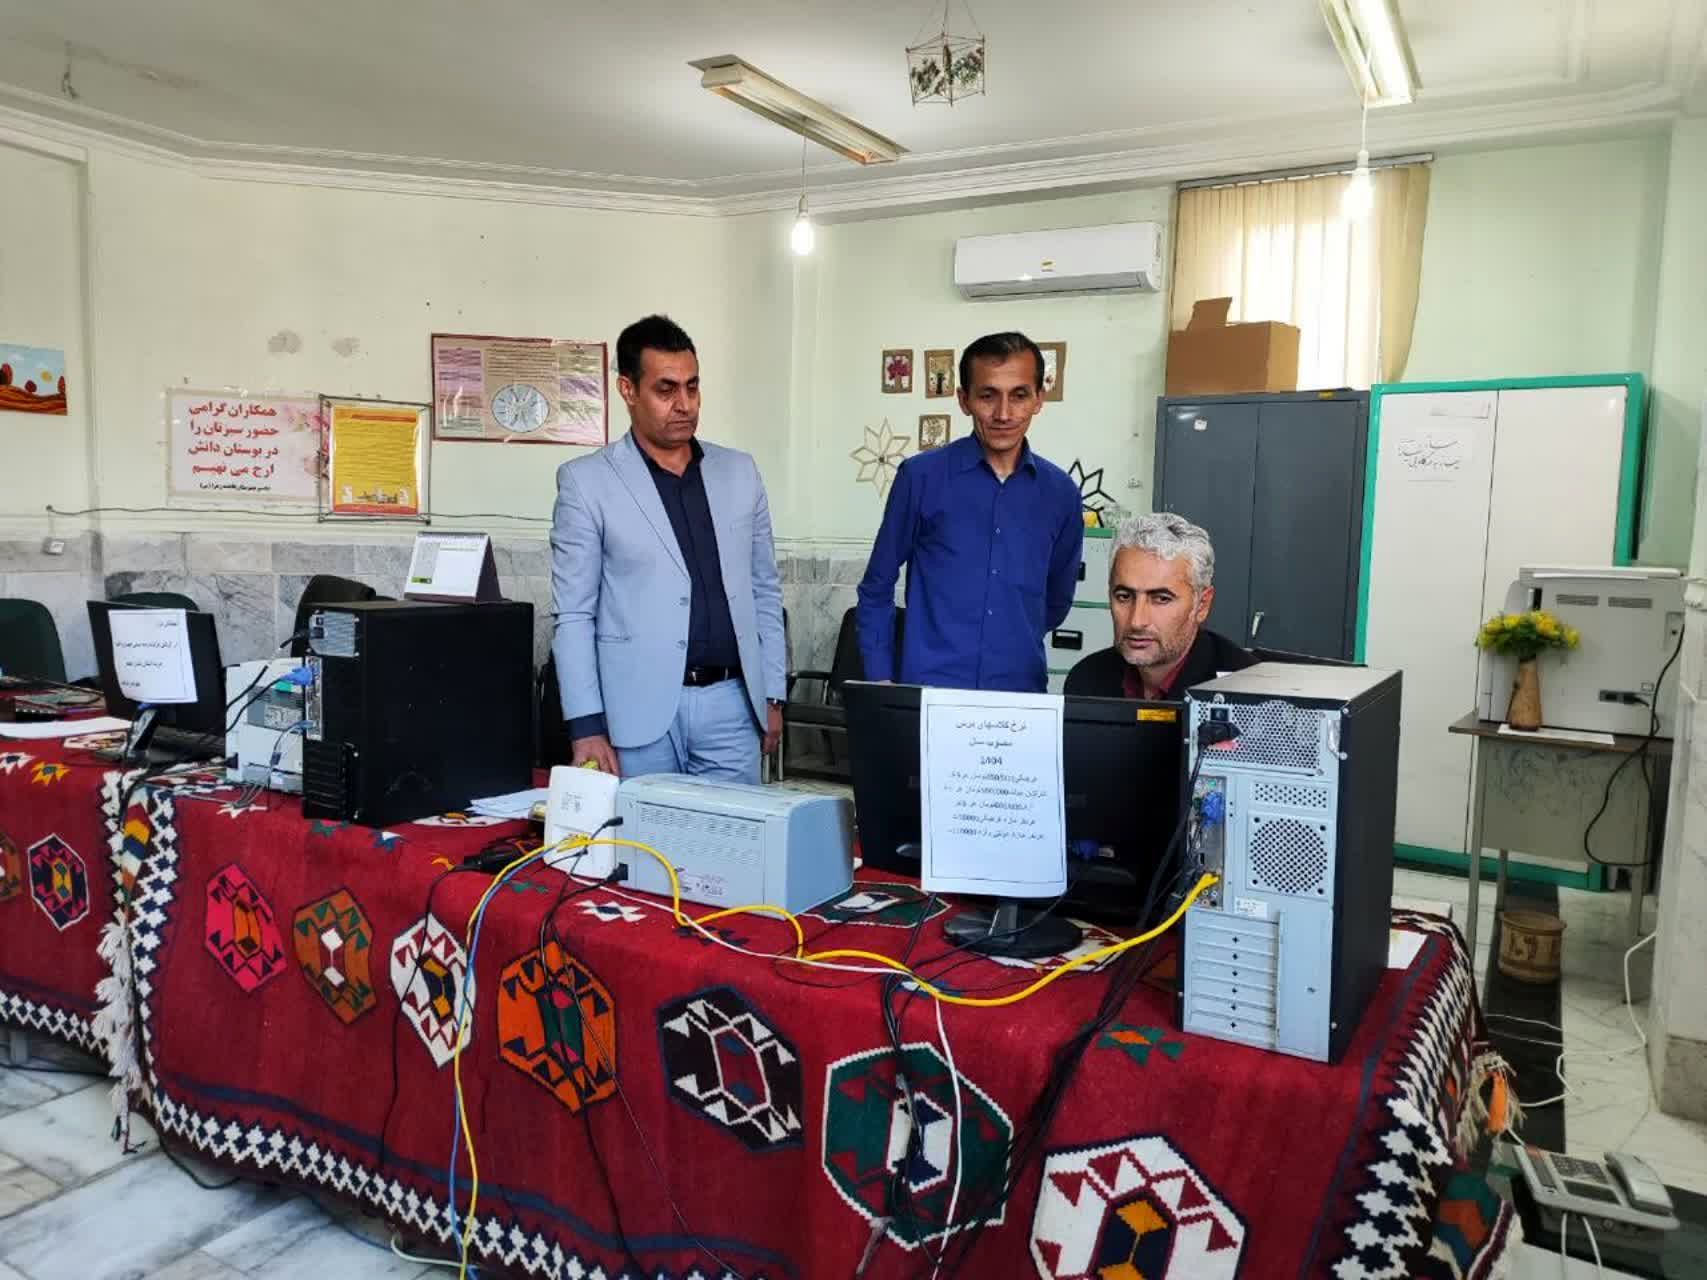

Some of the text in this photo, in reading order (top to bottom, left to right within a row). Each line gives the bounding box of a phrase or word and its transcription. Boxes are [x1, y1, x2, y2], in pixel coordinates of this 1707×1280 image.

[189, 401, 278, 418] همکاران گرامی
[190, 419, 201, 435] را
[246, 424, 279, 439] حضور
[188, 441, 279, 459] در بوستان دانش
[230, 466, 249, 476] می
[252, 464, 274, 478] ارج
